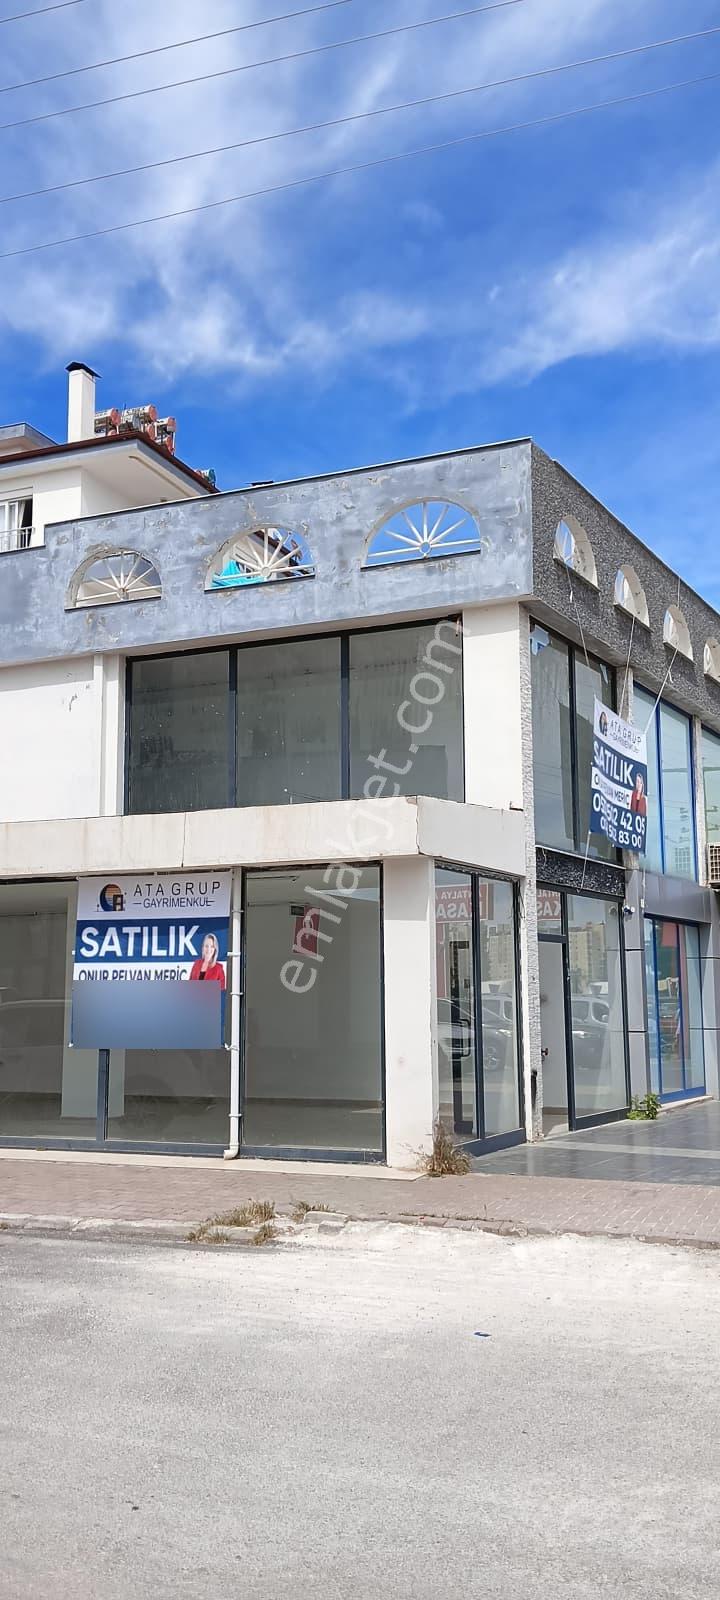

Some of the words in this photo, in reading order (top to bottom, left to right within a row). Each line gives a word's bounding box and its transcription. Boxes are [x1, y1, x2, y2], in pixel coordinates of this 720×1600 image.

[609, 719, 621, 733] ATA
[622, 727, 642, 745] GRUP
[593, 740, 635, 787] SATILIK
[620, 810, 633, 831] 42
[635, 815, 646, 836] 05
[618, 830, 630, 845] 83
[631, 833, 642, 849] 00
[133, 883, 165, 897] ATA
[171, 881, 221, 896] GRUP
[143, 896, 212, 909] GAYRİMENKUL
[79, 925, 200, 958] SATILIK
[78, 969, 109, 980] ONUR
